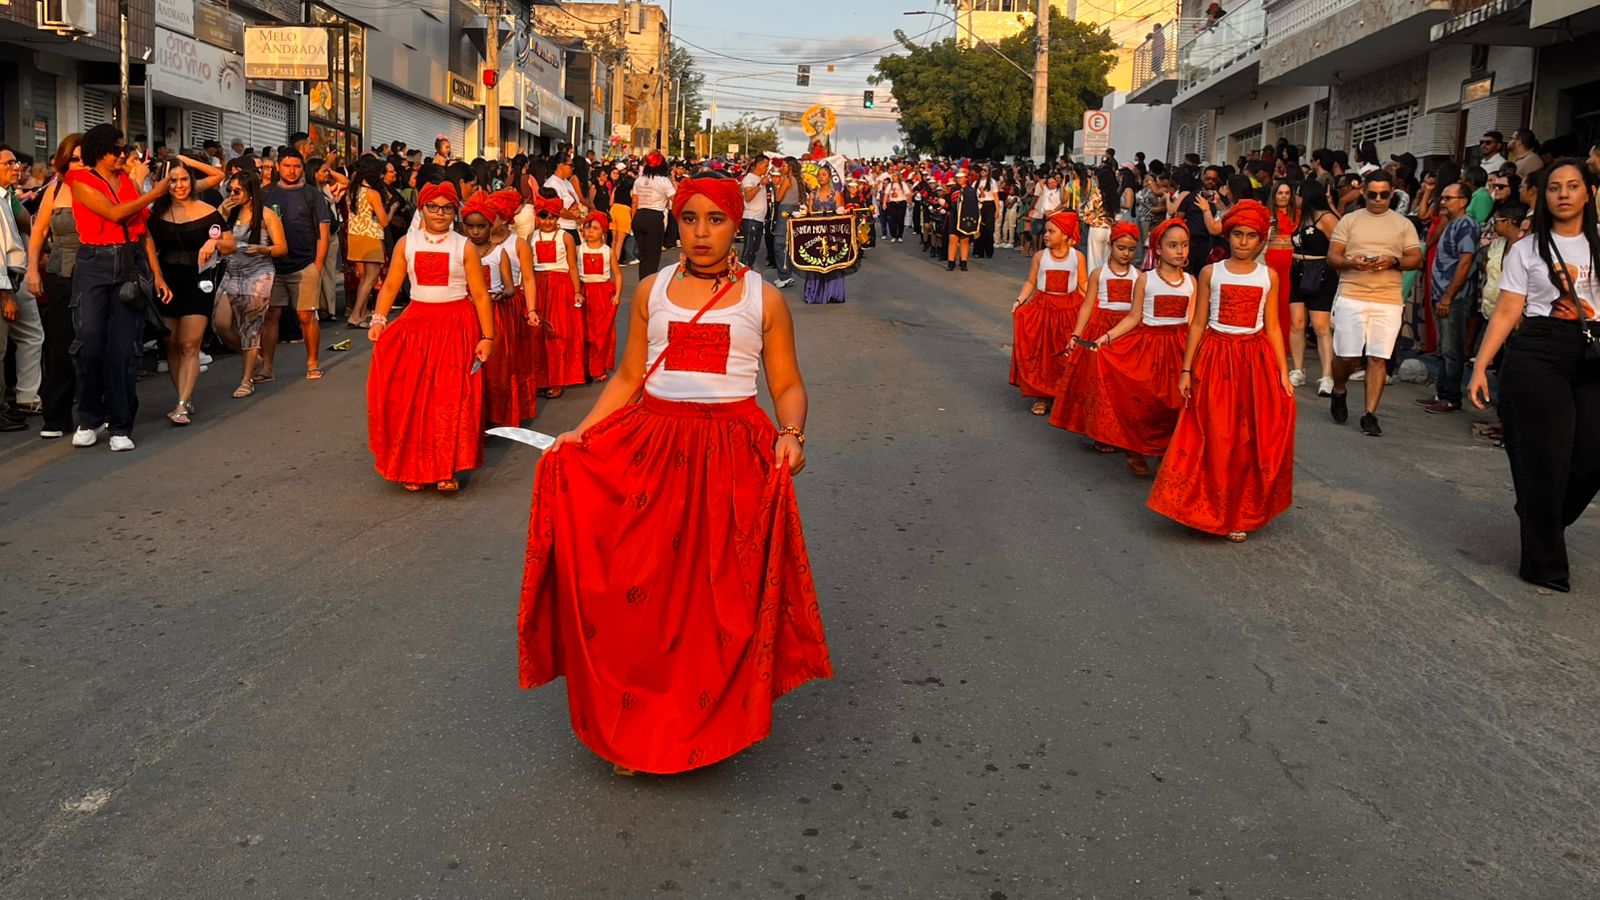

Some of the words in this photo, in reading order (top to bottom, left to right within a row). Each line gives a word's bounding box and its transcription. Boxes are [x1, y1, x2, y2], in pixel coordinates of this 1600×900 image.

[157, 3, 190, 24] ANDRADA
[260, 30, 297, 42] MELO
[167, 32, 197, 58] ÓTICA
[262, 43, 325, 55] ANDRADA
[157, 48, 182, 70] LHO
[184, 56, 211, 80] VIVO
[266, 67, 277, 75] 87
[279, 68, 297, 76] 3831
[302, 68, 321, 76] 3113
[1094, 117, 1101, 128] E
